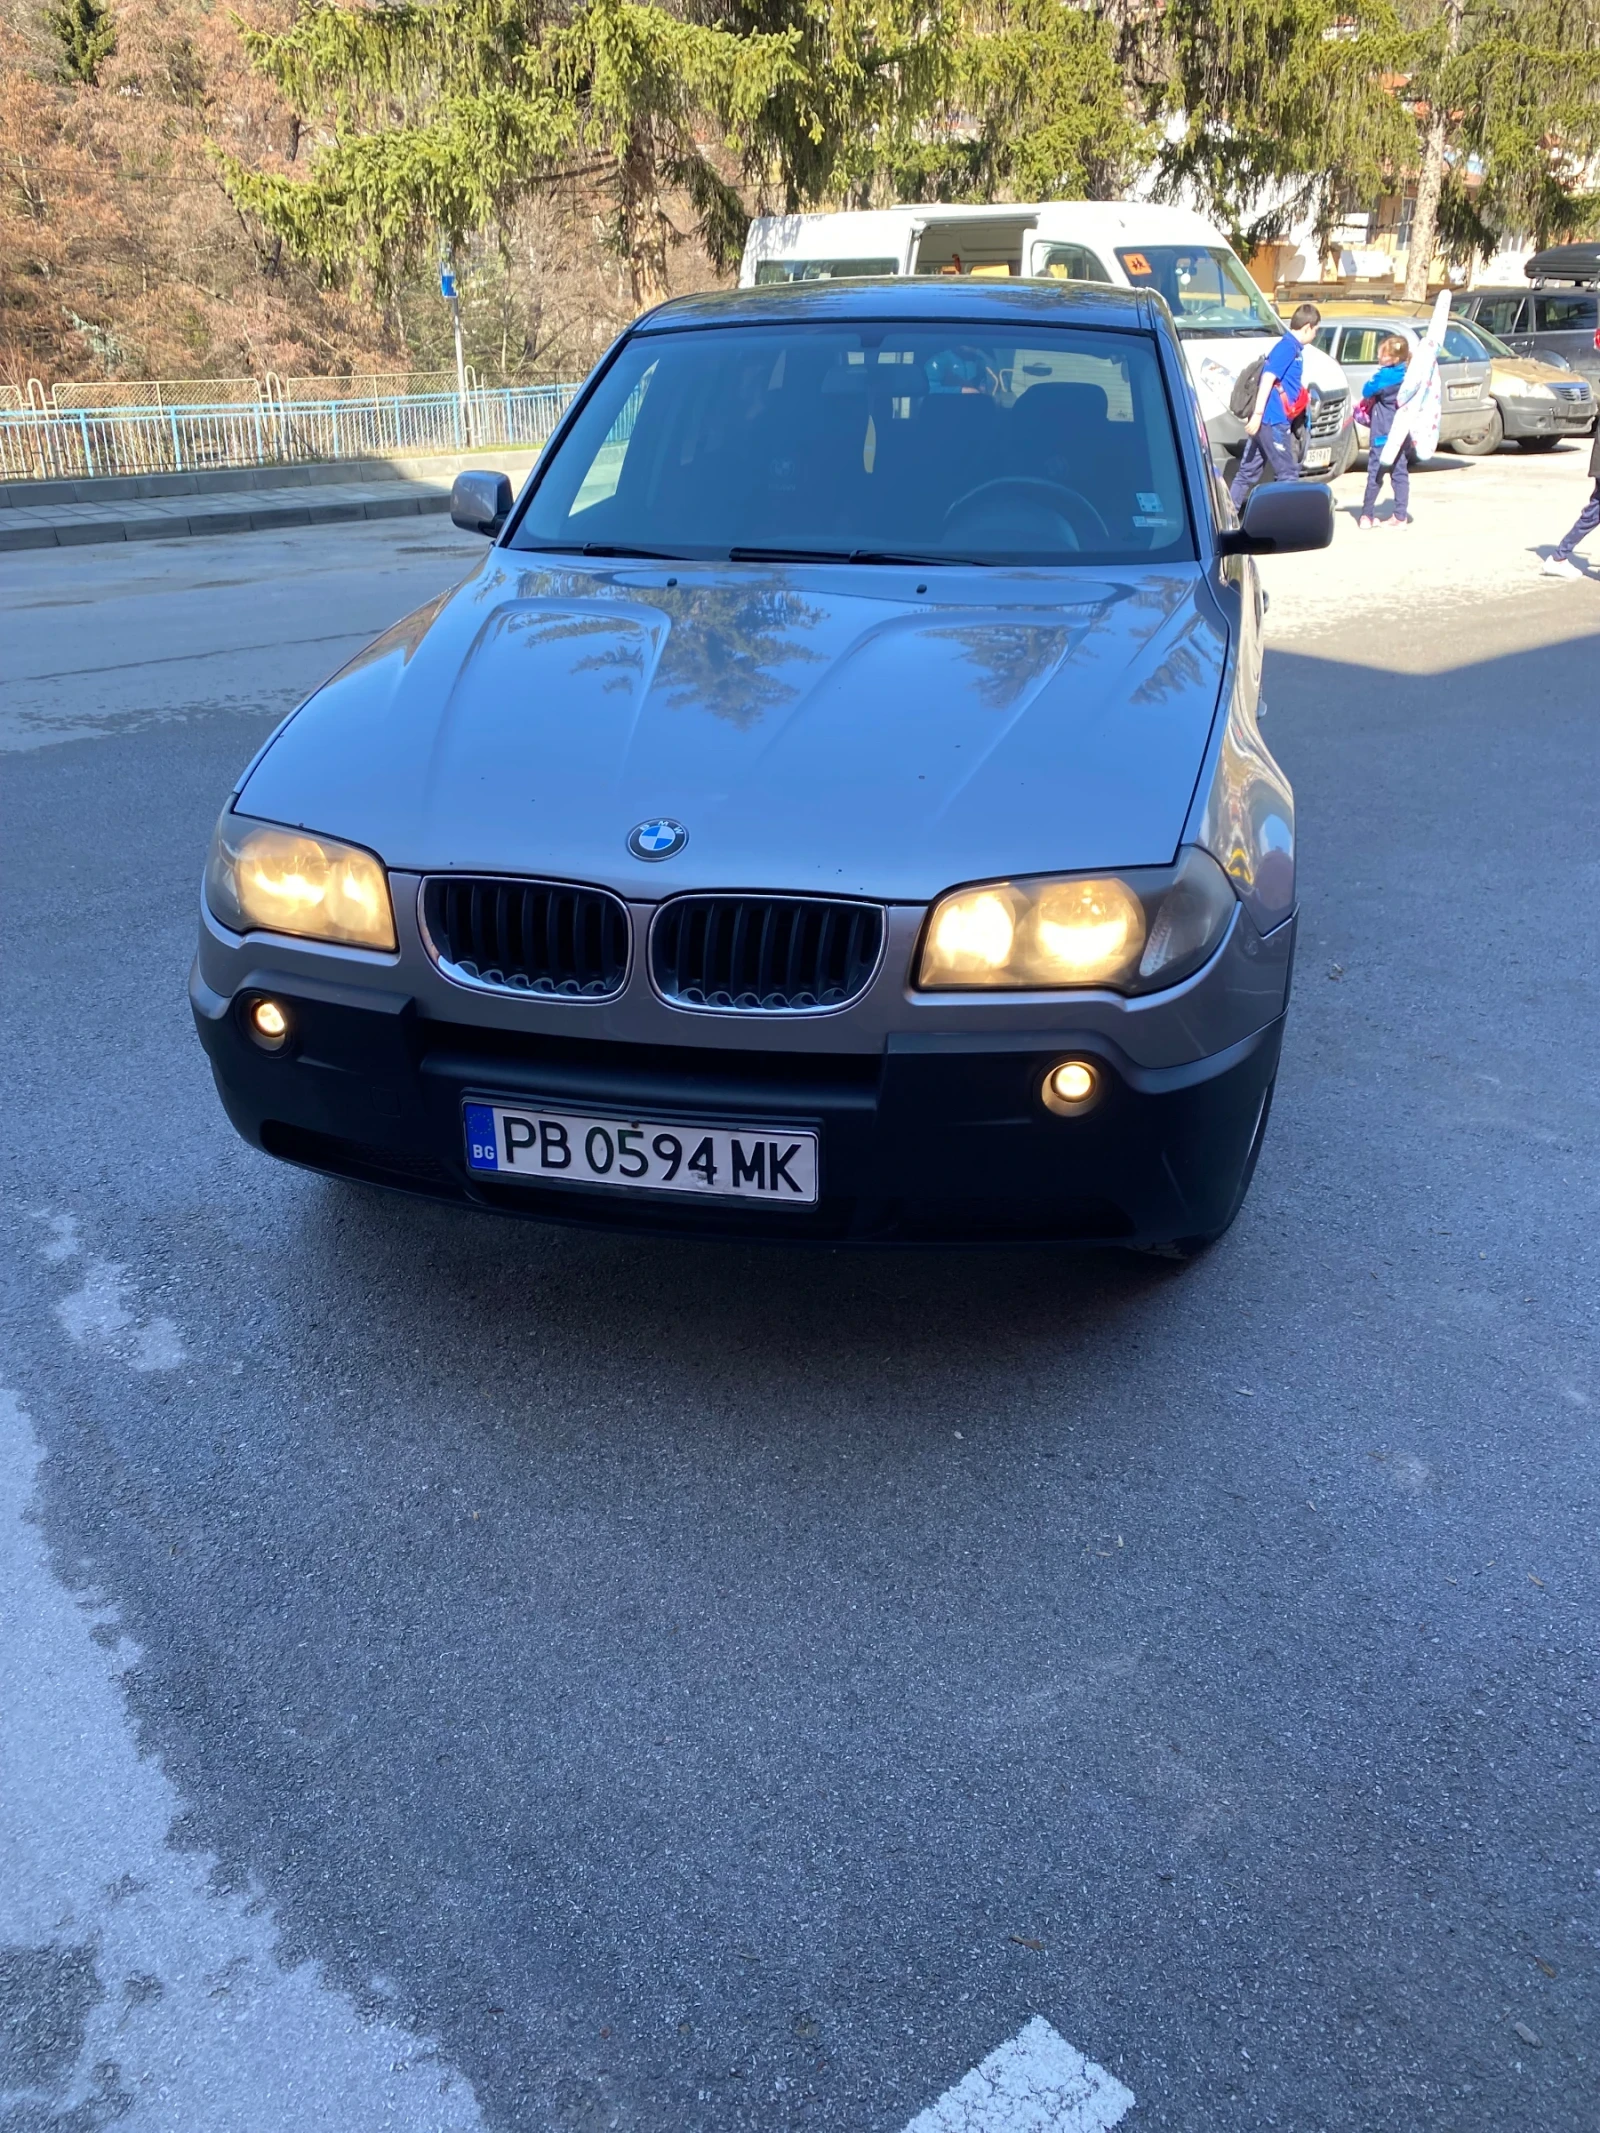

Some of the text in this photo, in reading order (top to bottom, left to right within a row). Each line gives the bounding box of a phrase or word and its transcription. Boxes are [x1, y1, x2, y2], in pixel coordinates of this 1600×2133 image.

[639, 820, 684, 835] BMW
[472, 1144, 495, 1160] BG
[502, 1115, 803, 1192] PB 0594 MK
